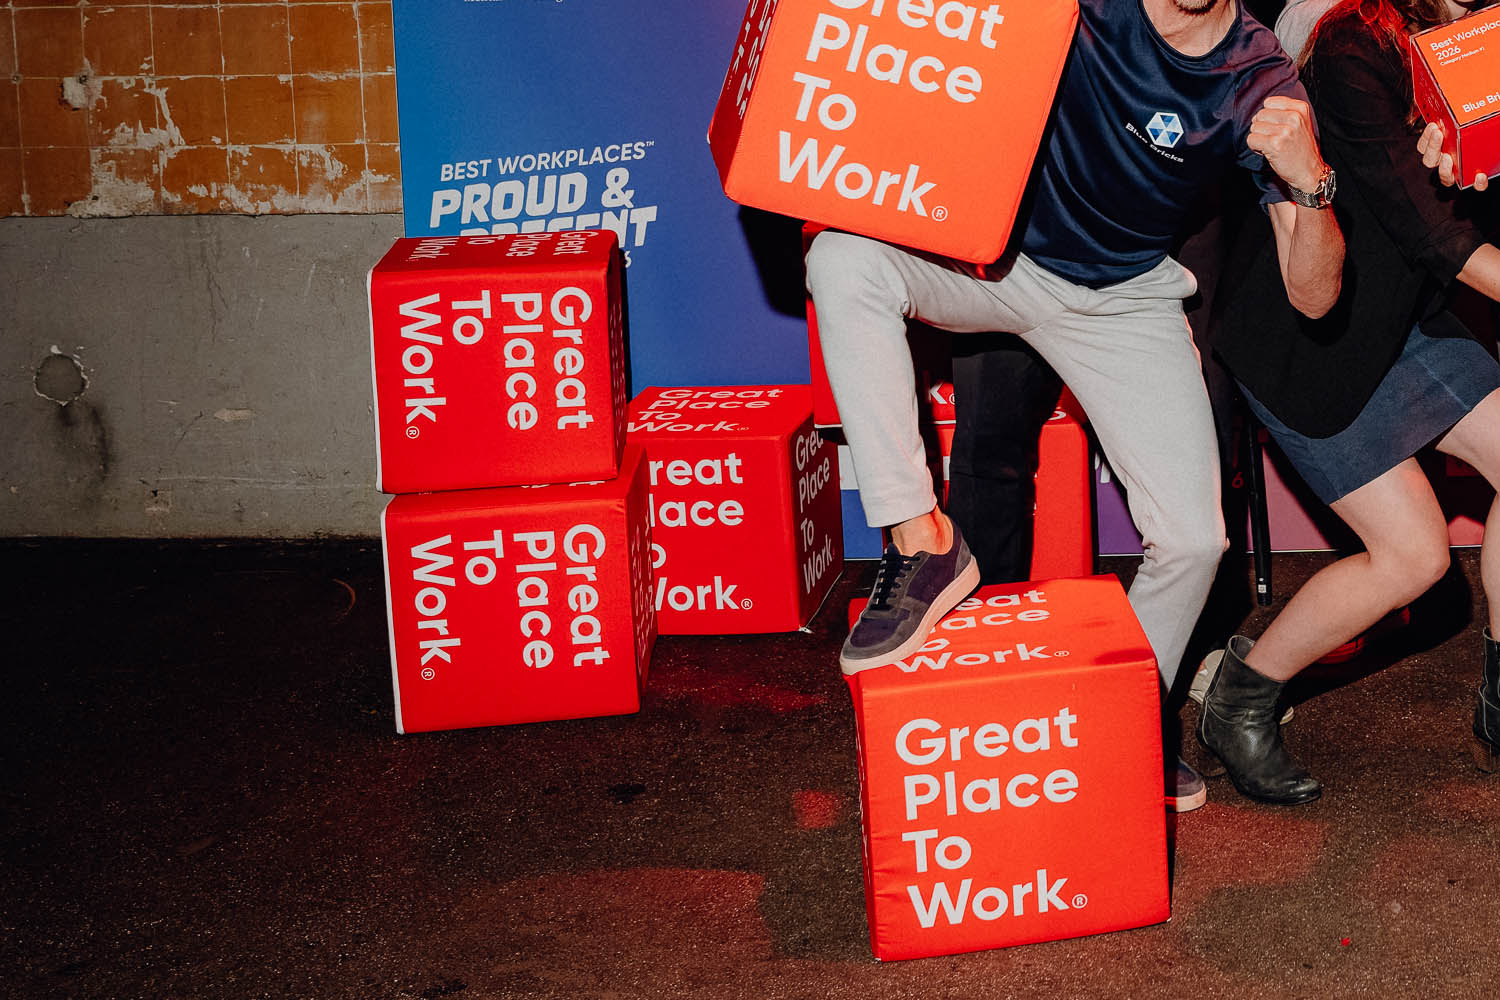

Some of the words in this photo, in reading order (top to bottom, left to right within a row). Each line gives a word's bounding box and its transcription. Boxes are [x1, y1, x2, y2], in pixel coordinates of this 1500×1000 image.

[806, 13, 982, 103] Place
[1430, 37, 1454, 51] Best
[1435, 45, 1461, 60] 2026
[793, 71, 856, 131] To
[1462, 99, 1486, 113] Blue
[430, 172, 588, 228] PROUD
[601, 168, 634, 208] &
[441, 159, 492, 181] BEST
[451, 289, 491, 346] To
[501, 292, 543, 431] Place
[550, 286, 593, 430] Great
[463, 529, 503, 585] To
[513, 530, 555, 670] Place
[563, 523, 610, 667] Great
[895, 706, 1079, 766] Great
[903, 767, 1079, 822] Place
[901, 828, 971, 873] To
